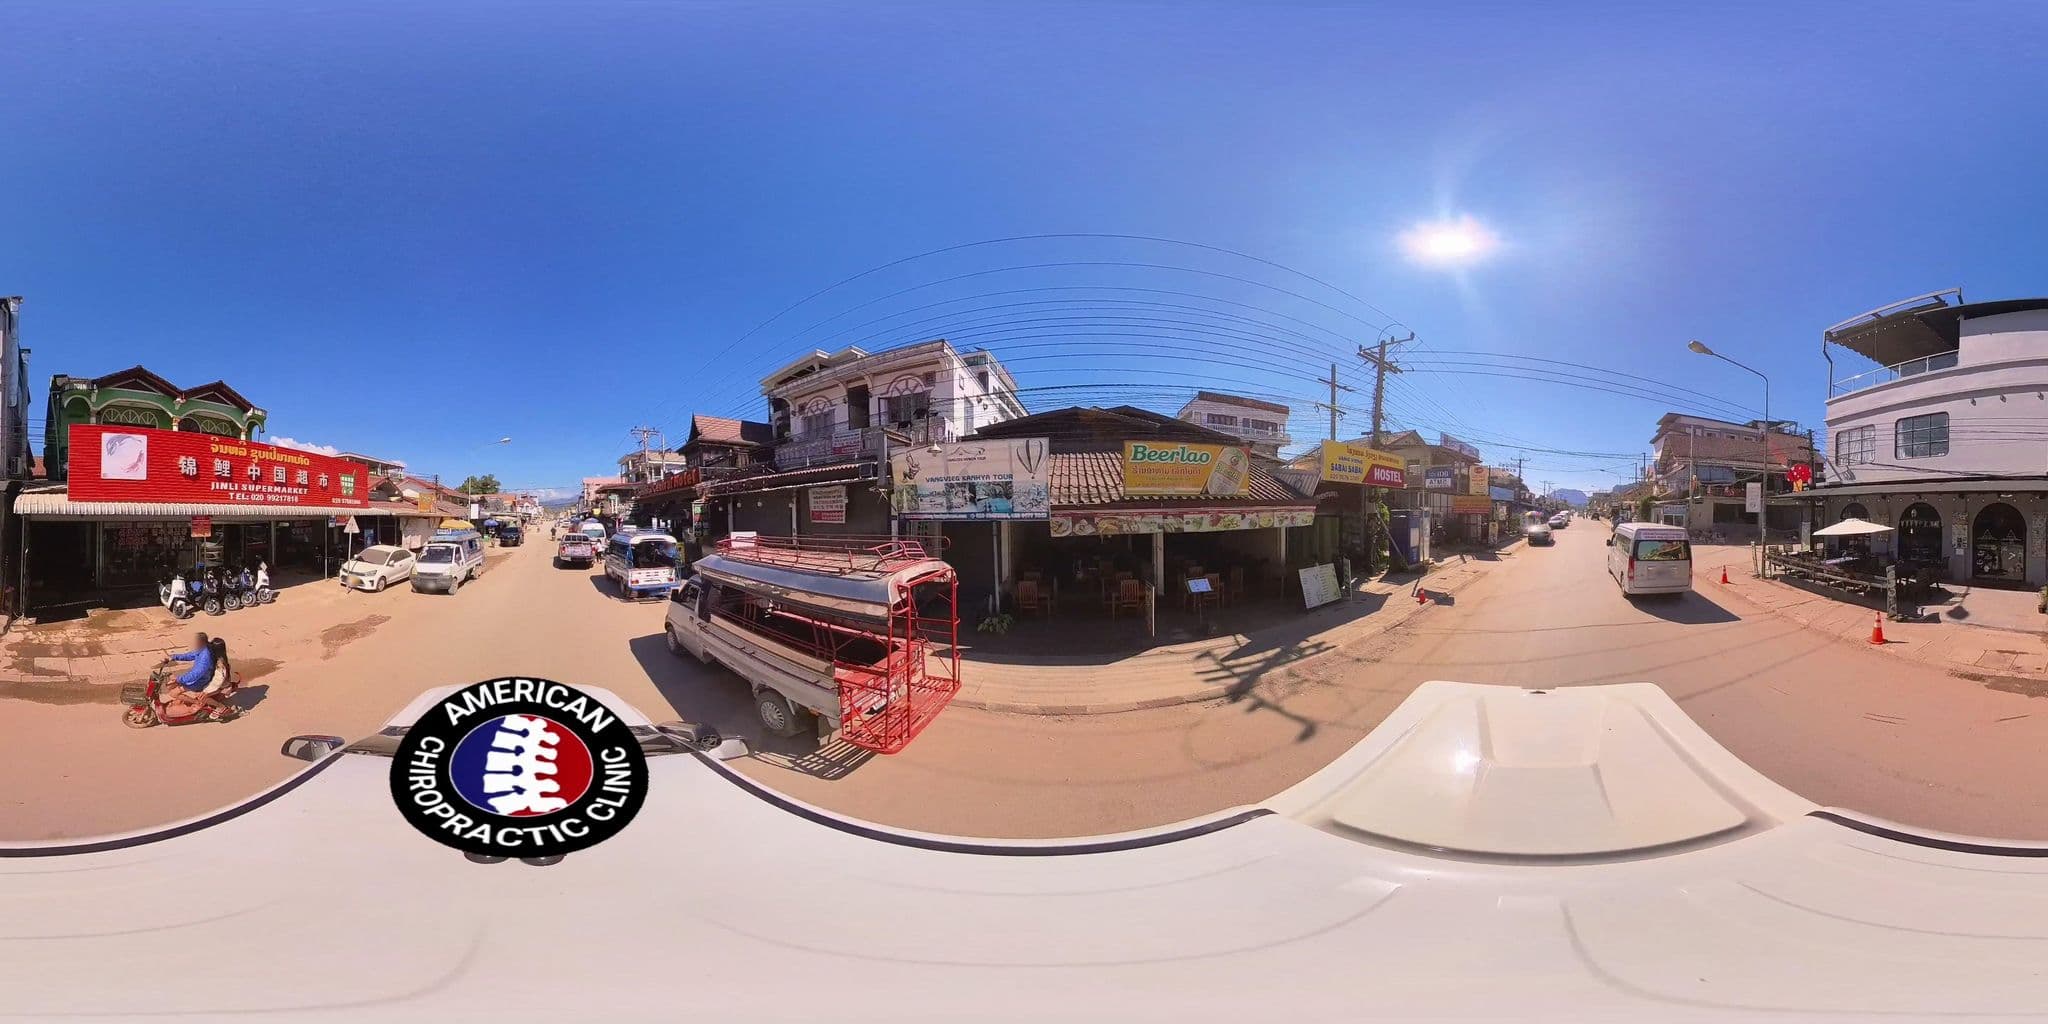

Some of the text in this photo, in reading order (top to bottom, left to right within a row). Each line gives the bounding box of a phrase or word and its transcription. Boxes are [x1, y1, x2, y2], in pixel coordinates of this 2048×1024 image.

[1129, 444, 1212, 464] Beerlao
[178, 456, 329, 488] 锦鲤中国超市
[993, 473, 1014, 481] TOUR
[1373, 468, 1402, 483] HOSTEL
[211, 482, 308, 495] JINLI SUPERMARKET
